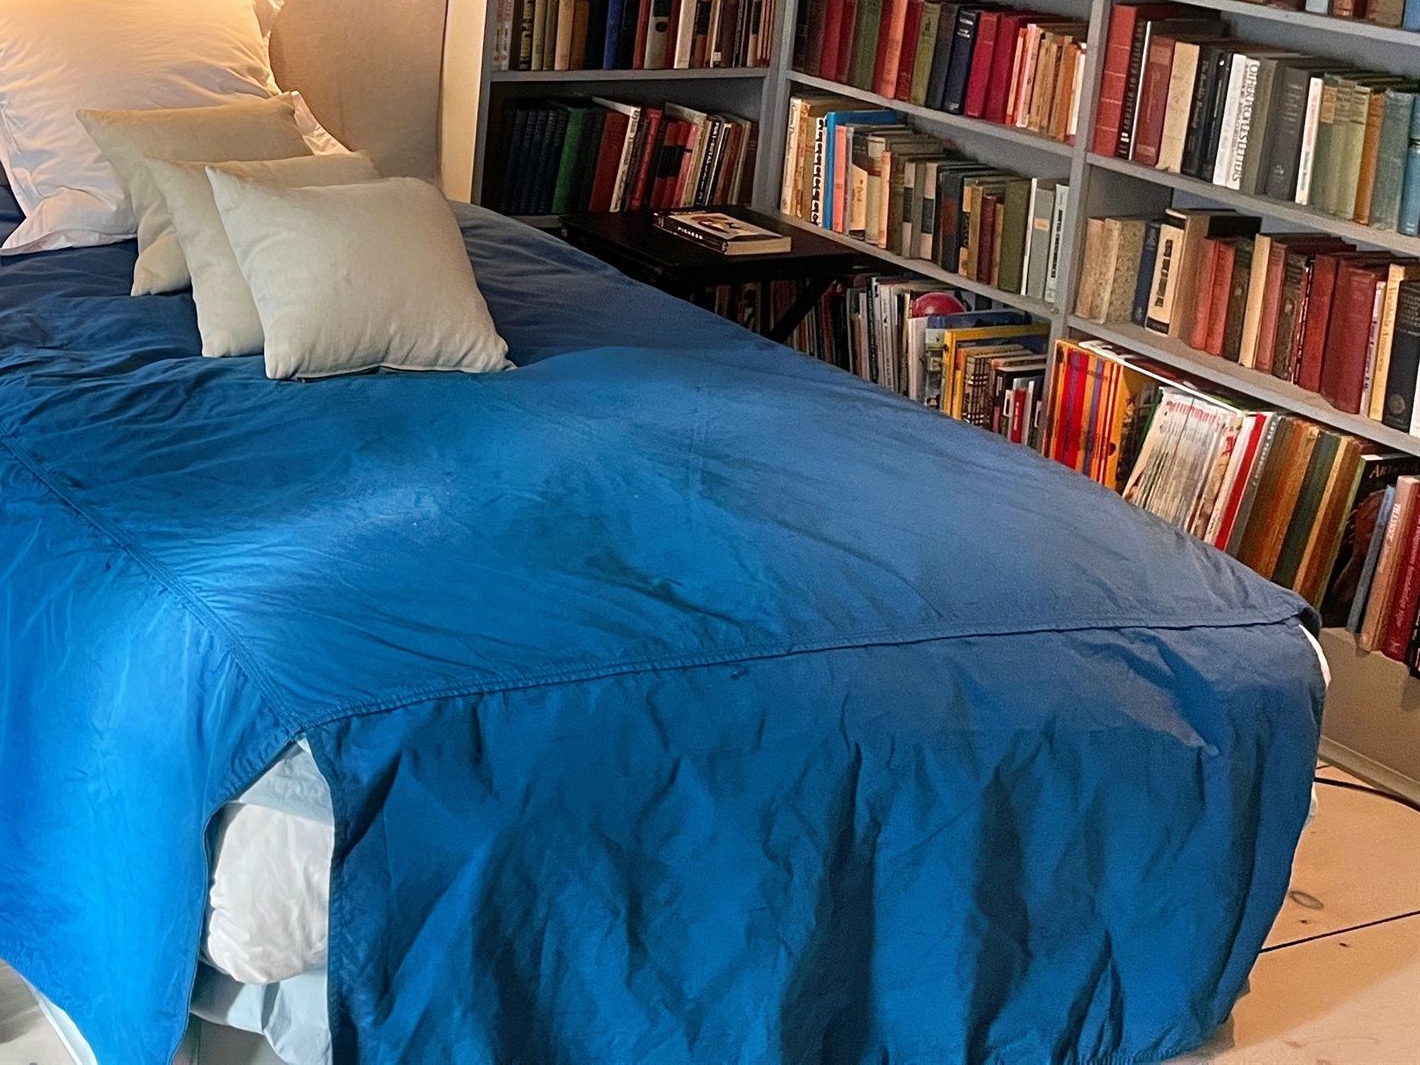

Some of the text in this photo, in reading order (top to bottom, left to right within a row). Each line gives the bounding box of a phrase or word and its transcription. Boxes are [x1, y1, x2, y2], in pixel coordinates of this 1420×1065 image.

[623, 110, 640, 165] Dylan Thomas
[1232, 64, 1259, 182] OTHER LETTERS
